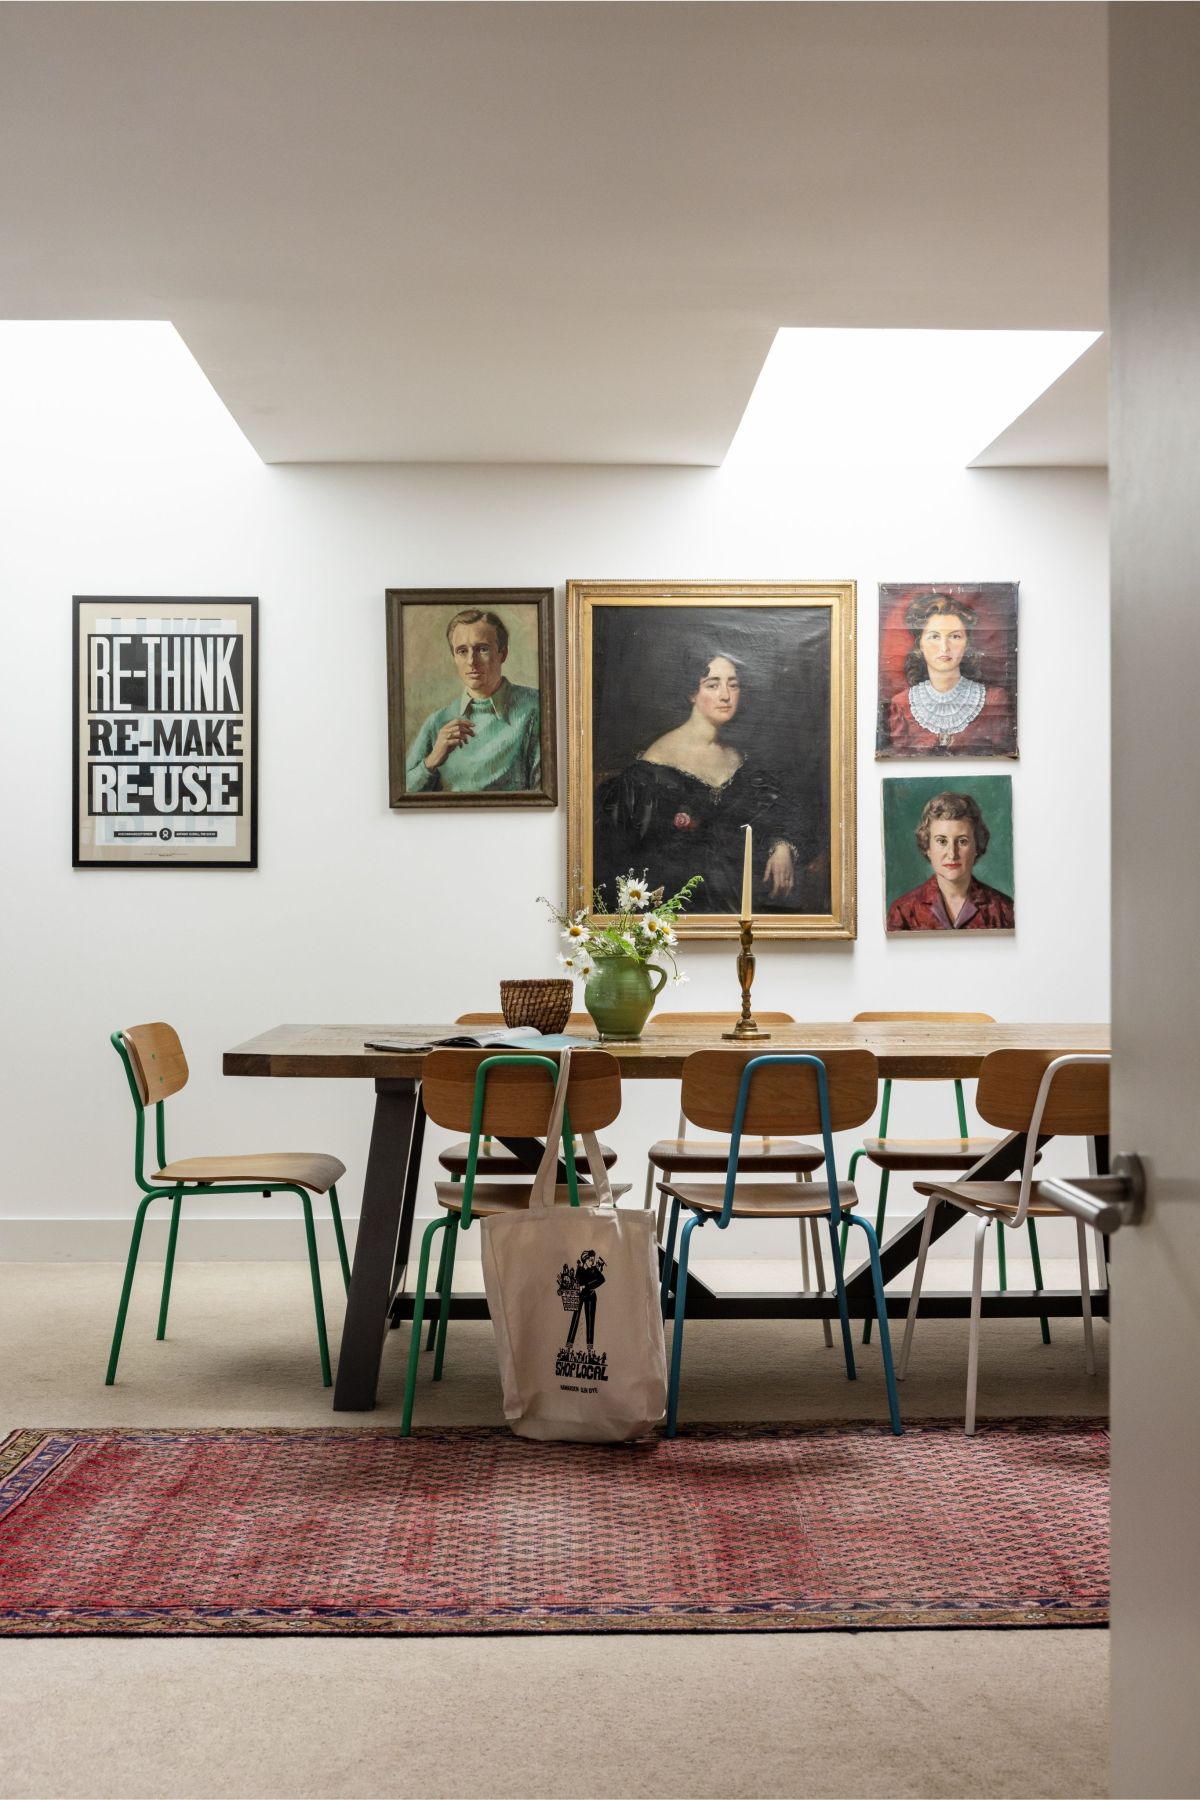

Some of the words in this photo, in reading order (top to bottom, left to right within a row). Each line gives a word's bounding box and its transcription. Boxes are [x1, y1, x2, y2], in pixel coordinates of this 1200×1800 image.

[89, 636, 241, 712] RE-THINK
[88, 719, 243, 756] RE-MAKE
[92, 765, 239, 813] RE-USE
[555, 1361, 576, 1377] SHOP
[576, 1364, 608, 1381] LOCAL
